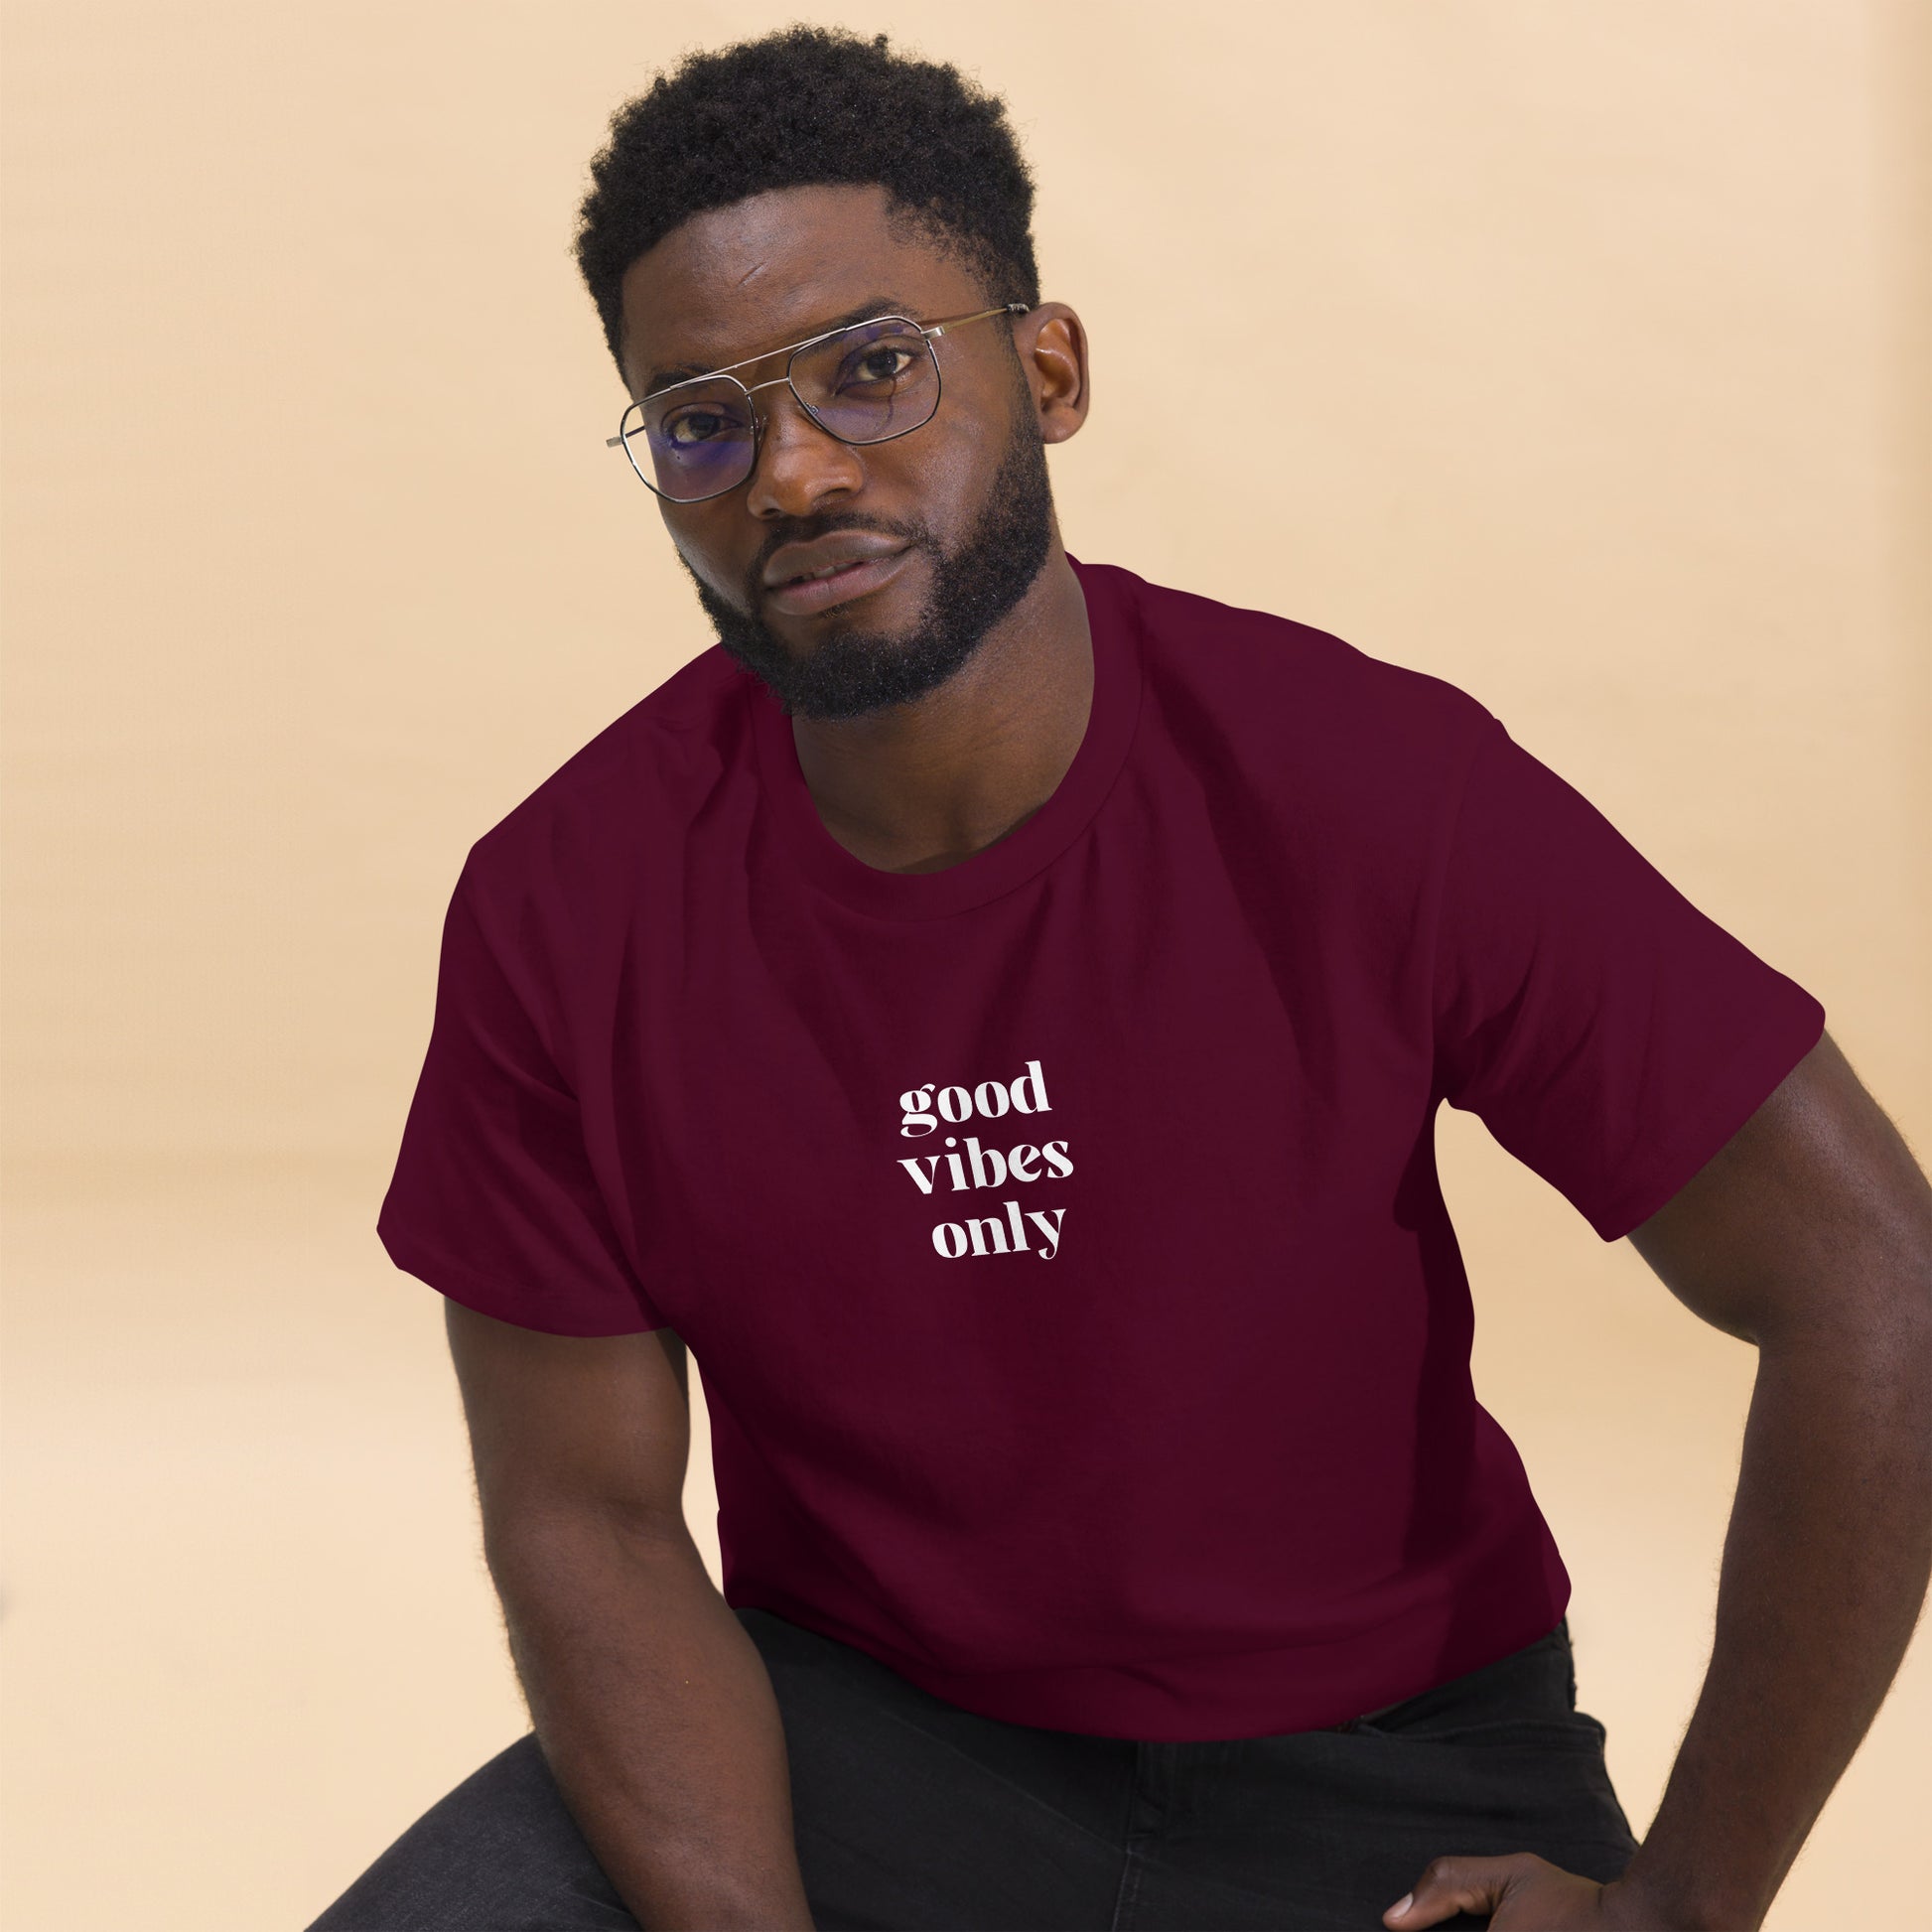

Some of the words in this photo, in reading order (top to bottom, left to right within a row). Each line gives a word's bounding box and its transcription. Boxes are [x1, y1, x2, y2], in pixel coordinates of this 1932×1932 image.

[898, 1059, 1052, 1138] good
[897, 1137, 1074, 1195] vibes
[931, 1200, 1067, 1260] only
